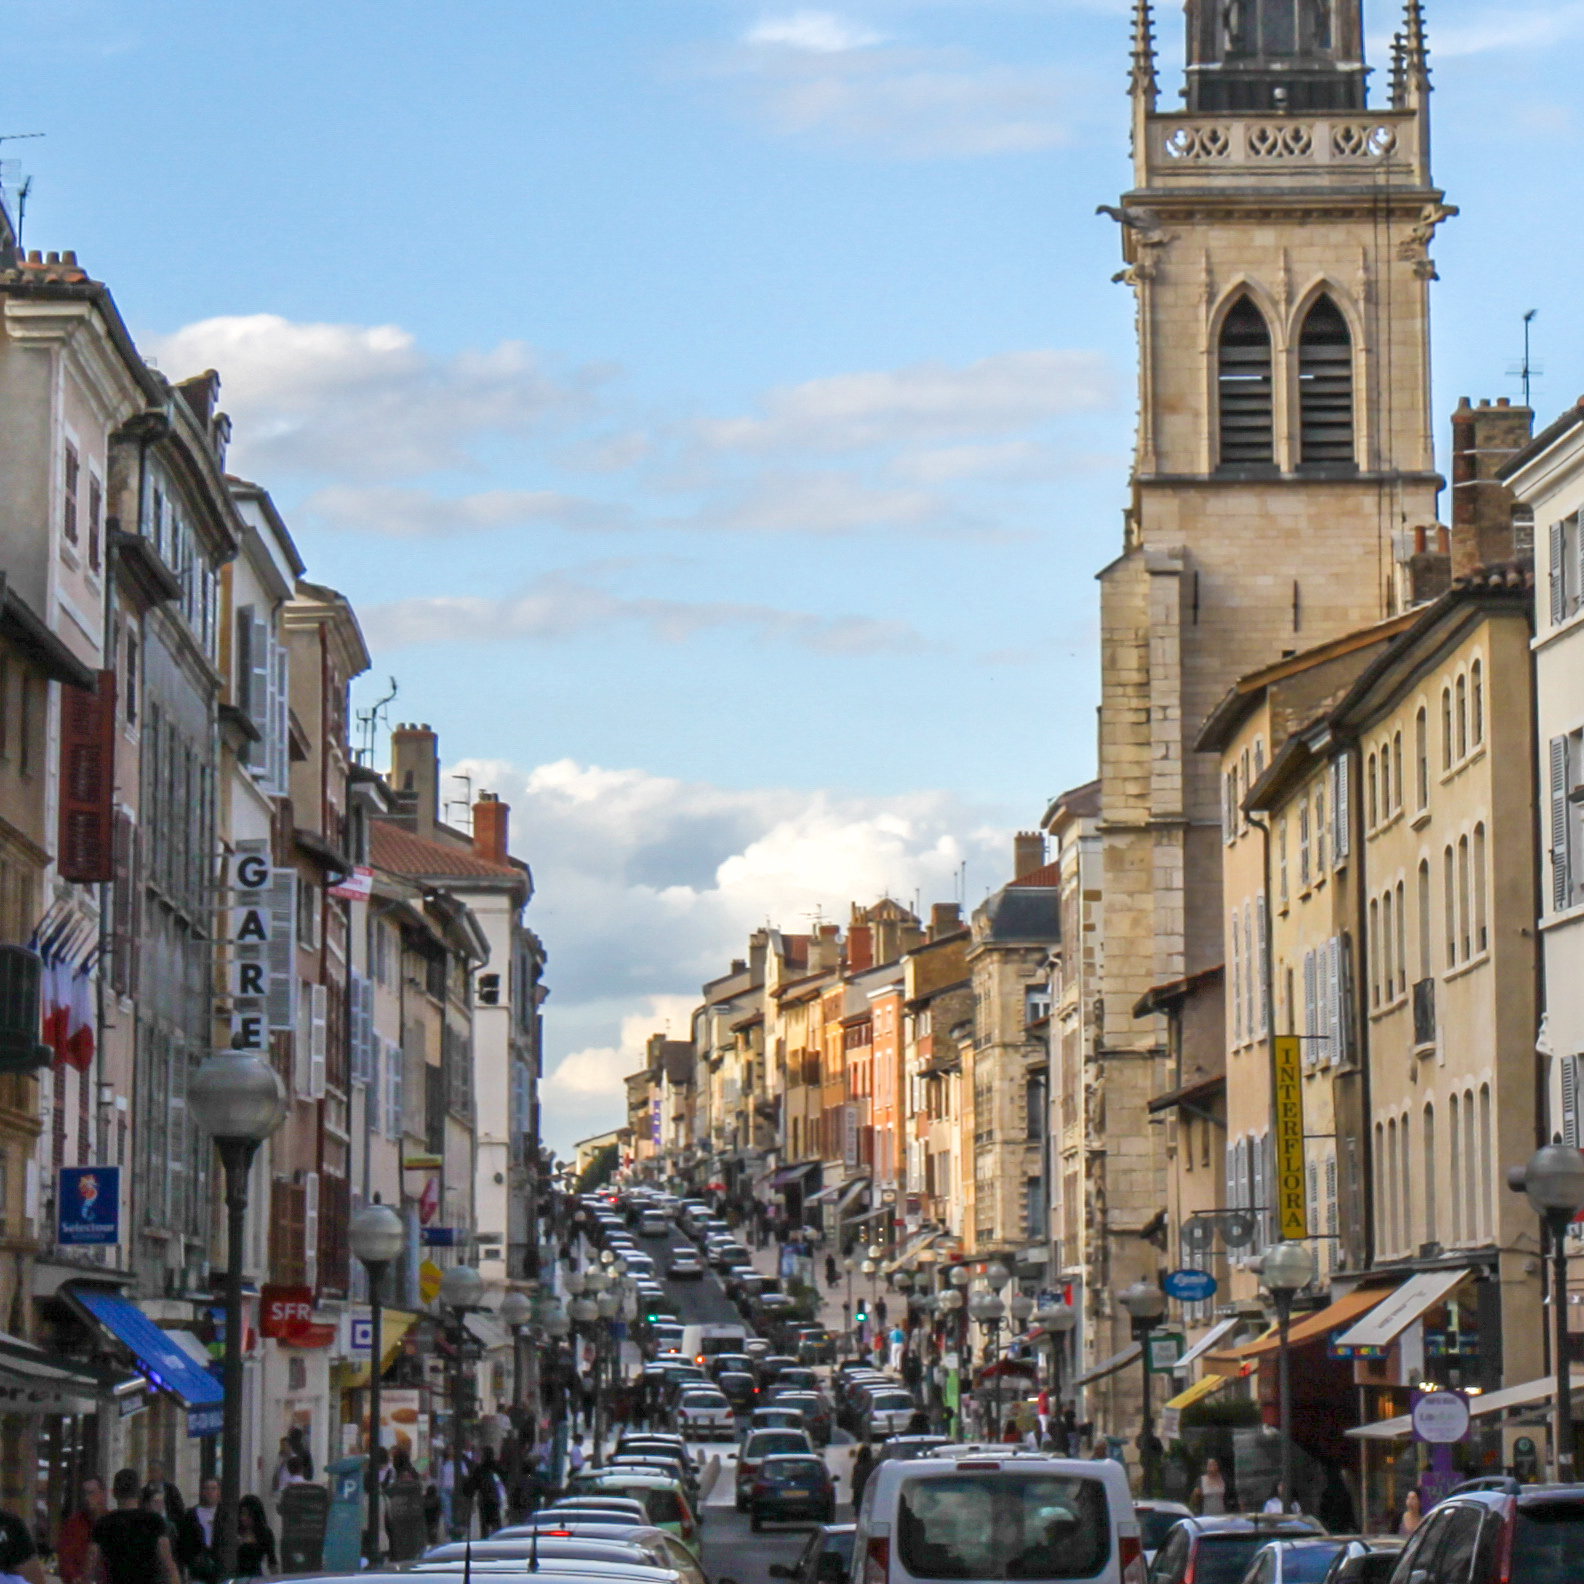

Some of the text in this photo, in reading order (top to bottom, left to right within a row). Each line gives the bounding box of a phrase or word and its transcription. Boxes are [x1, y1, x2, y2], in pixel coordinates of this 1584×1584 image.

[236, 856, 269, 1049] GARE
[1279, 1048, 1302, 1228] INTERFLORA
[271, 1302, 312, 1322] SFR
[344, 1480, 358, 1500] P
